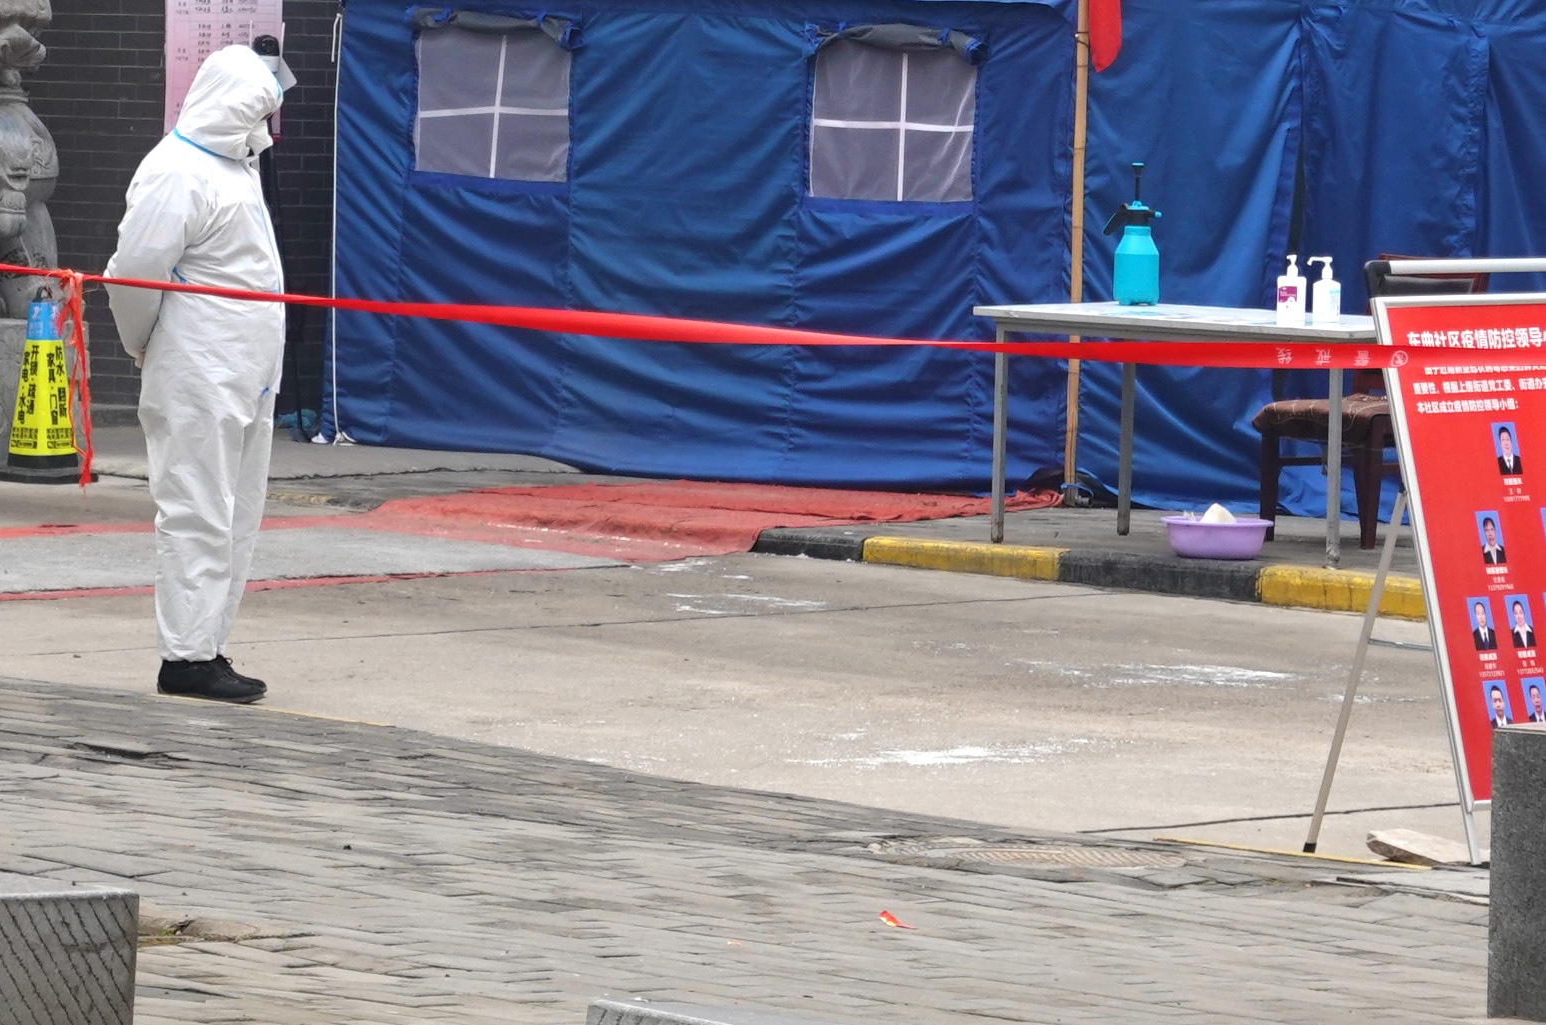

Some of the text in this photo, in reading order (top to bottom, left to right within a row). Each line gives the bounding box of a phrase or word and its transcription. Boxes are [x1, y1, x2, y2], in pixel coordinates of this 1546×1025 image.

[1406, 327, 1546, 349] 东曲社区疫情防控领导
